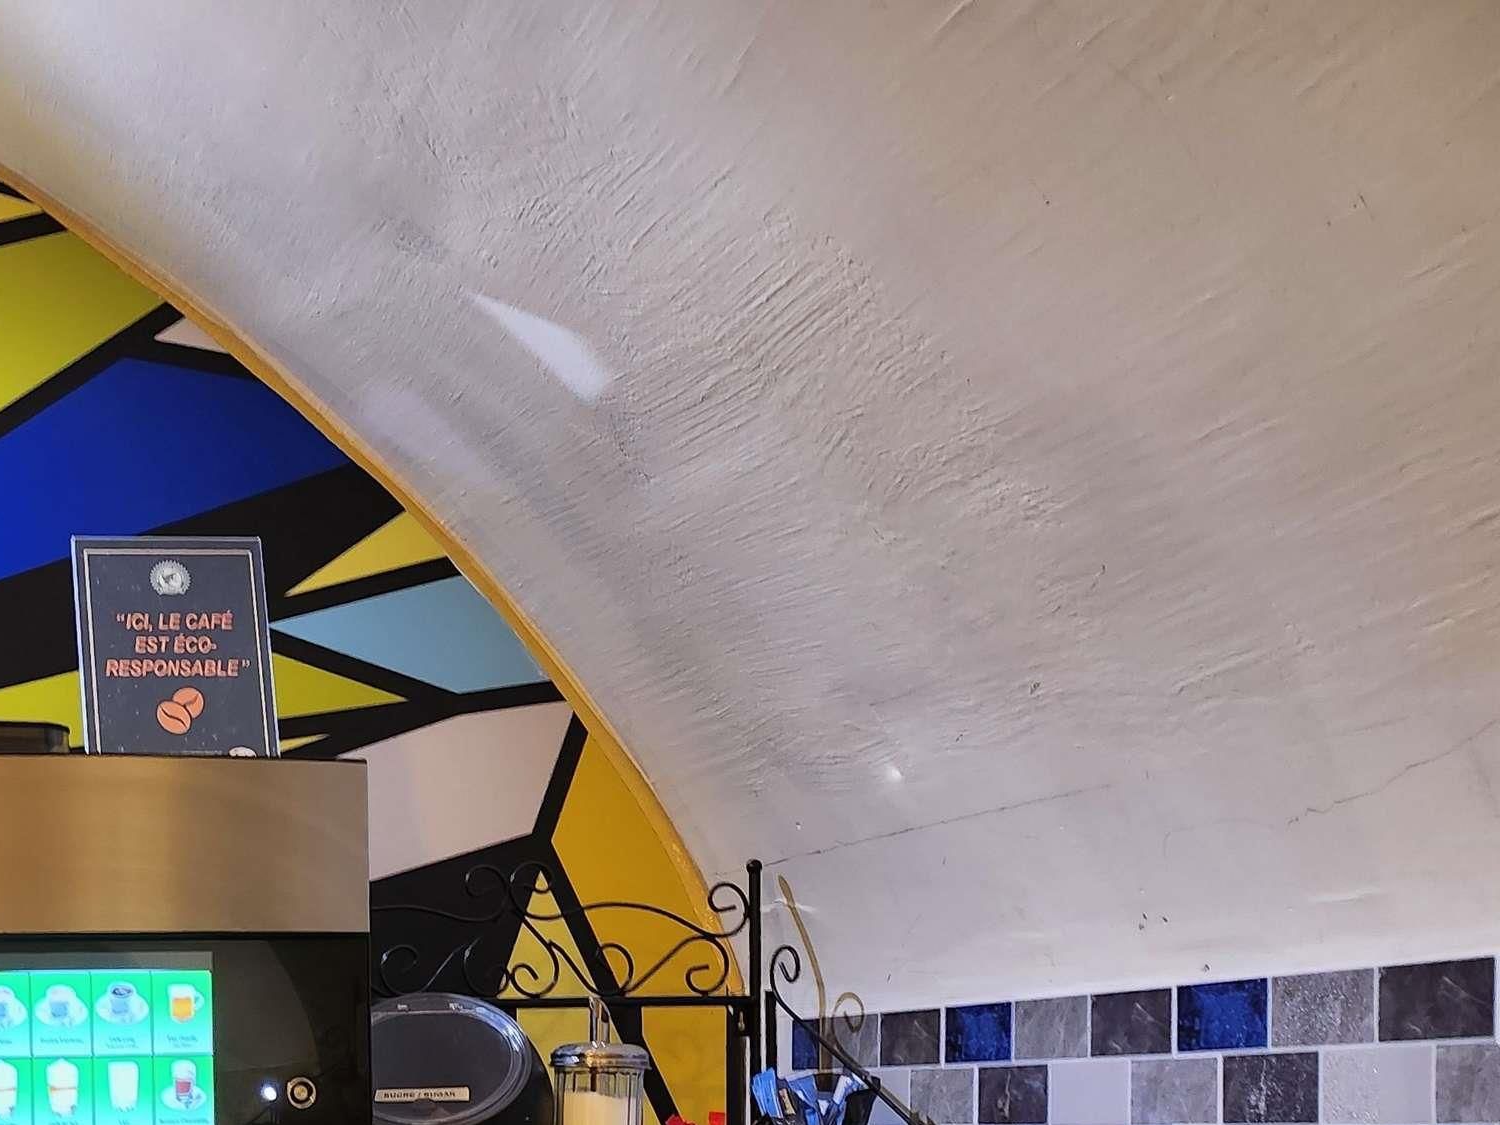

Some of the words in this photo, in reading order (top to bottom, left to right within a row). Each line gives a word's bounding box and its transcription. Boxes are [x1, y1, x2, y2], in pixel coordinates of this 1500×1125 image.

[158, 612, 180, 630] LE
[185, 609, 233, 630] CAFÉ
[135, 635, 169, 654] EST
